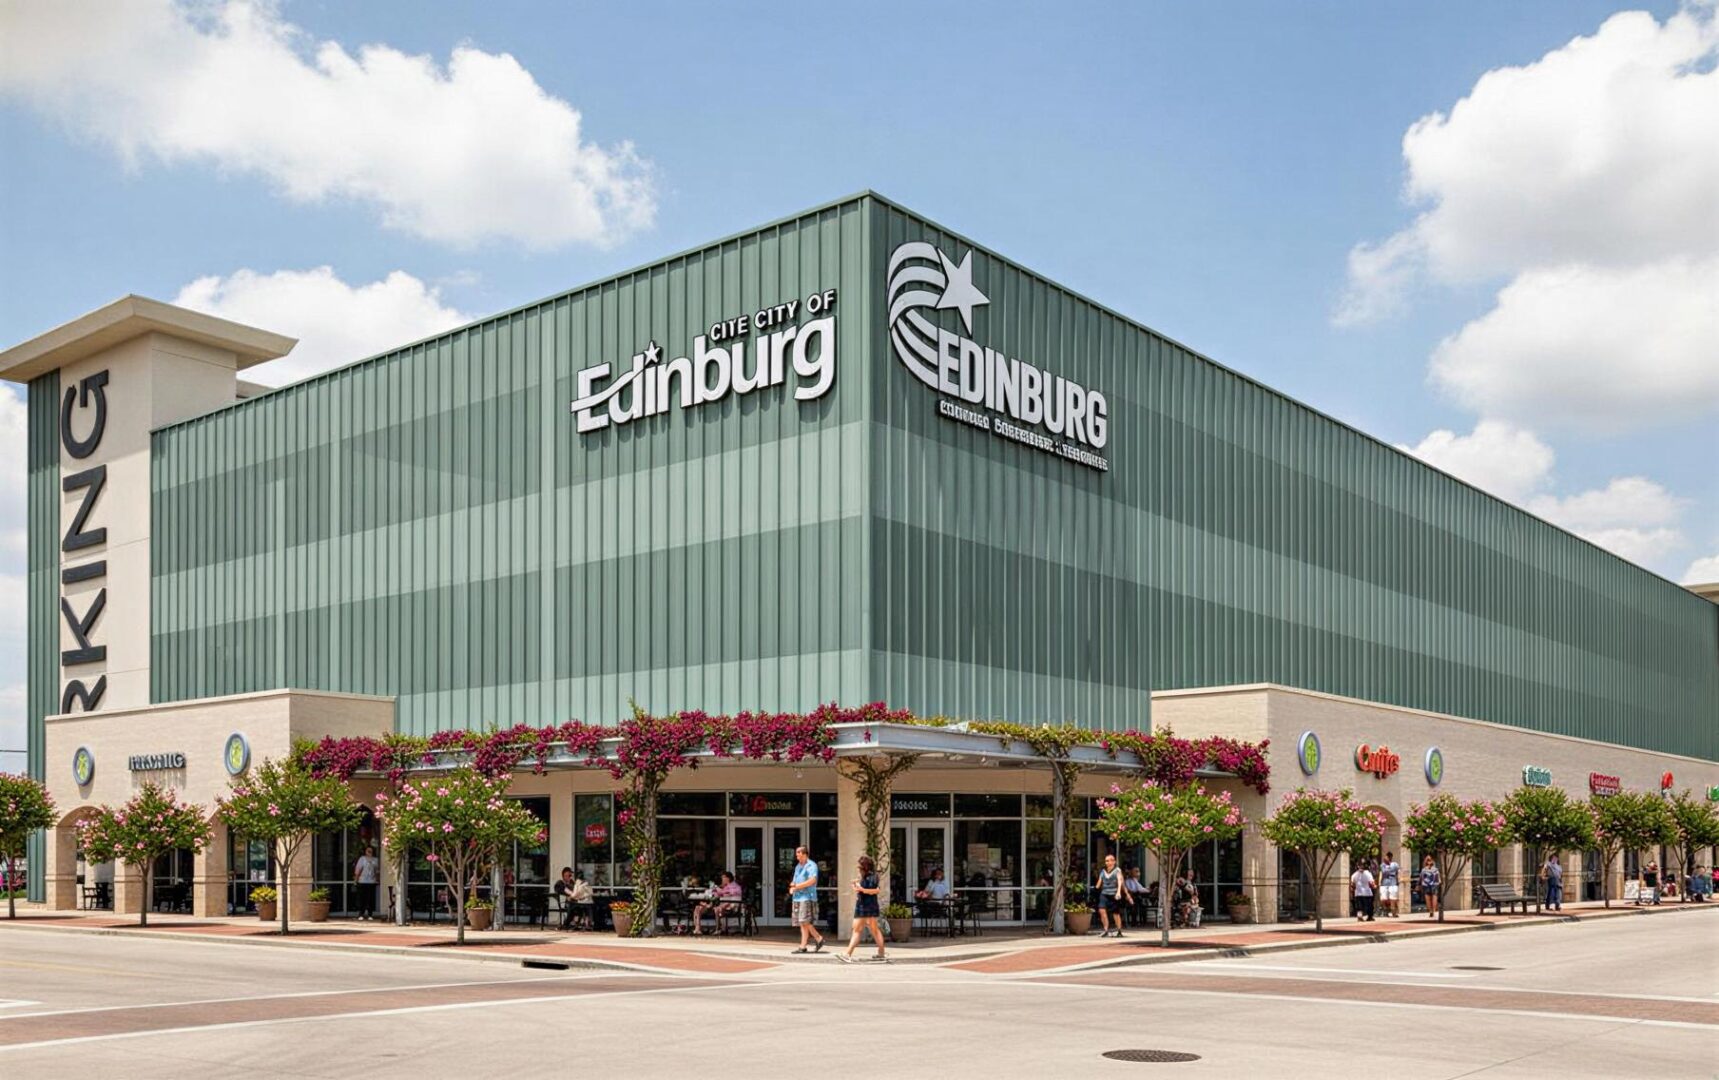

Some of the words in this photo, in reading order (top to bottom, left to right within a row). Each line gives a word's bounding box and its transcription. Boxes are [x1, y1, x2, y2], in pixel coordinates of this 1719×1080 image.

[754, 300, 798, 329] CITY
[806, 290, 835, 314] OF
[571, 315, 836, 433] Edinburg
[938, 327, 1107, 449] EDINBURG
